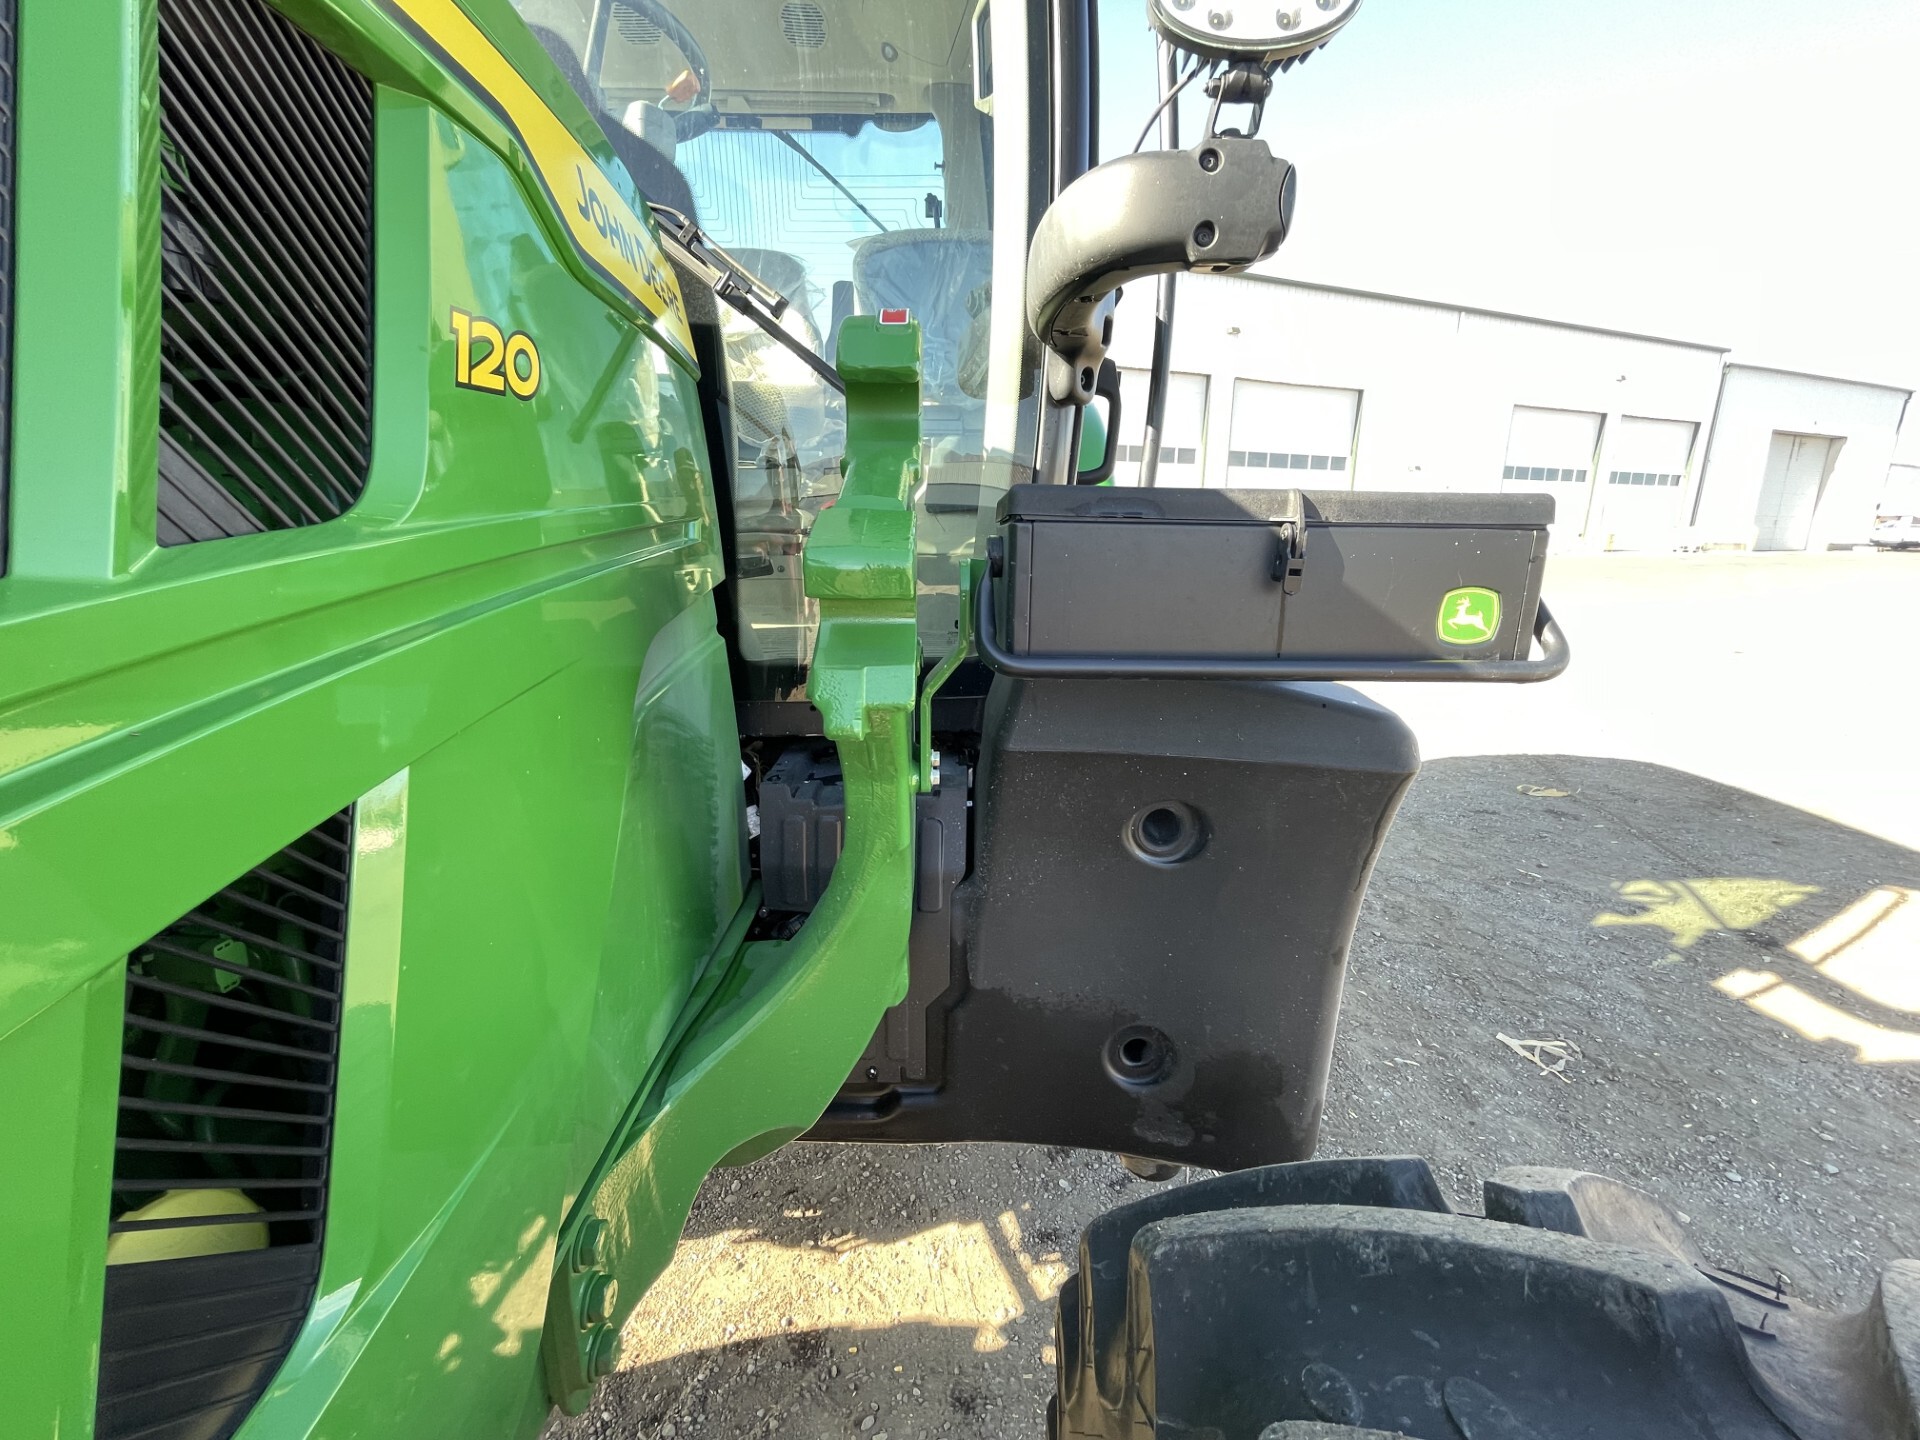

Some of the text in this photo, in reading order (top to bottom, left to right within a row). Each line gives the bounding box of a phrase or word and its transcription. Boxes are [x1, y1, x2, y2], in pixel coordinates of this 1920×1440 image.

[576, 164, 683, 325] JOHN DEERE
[450, 305, 540, 401] 120
